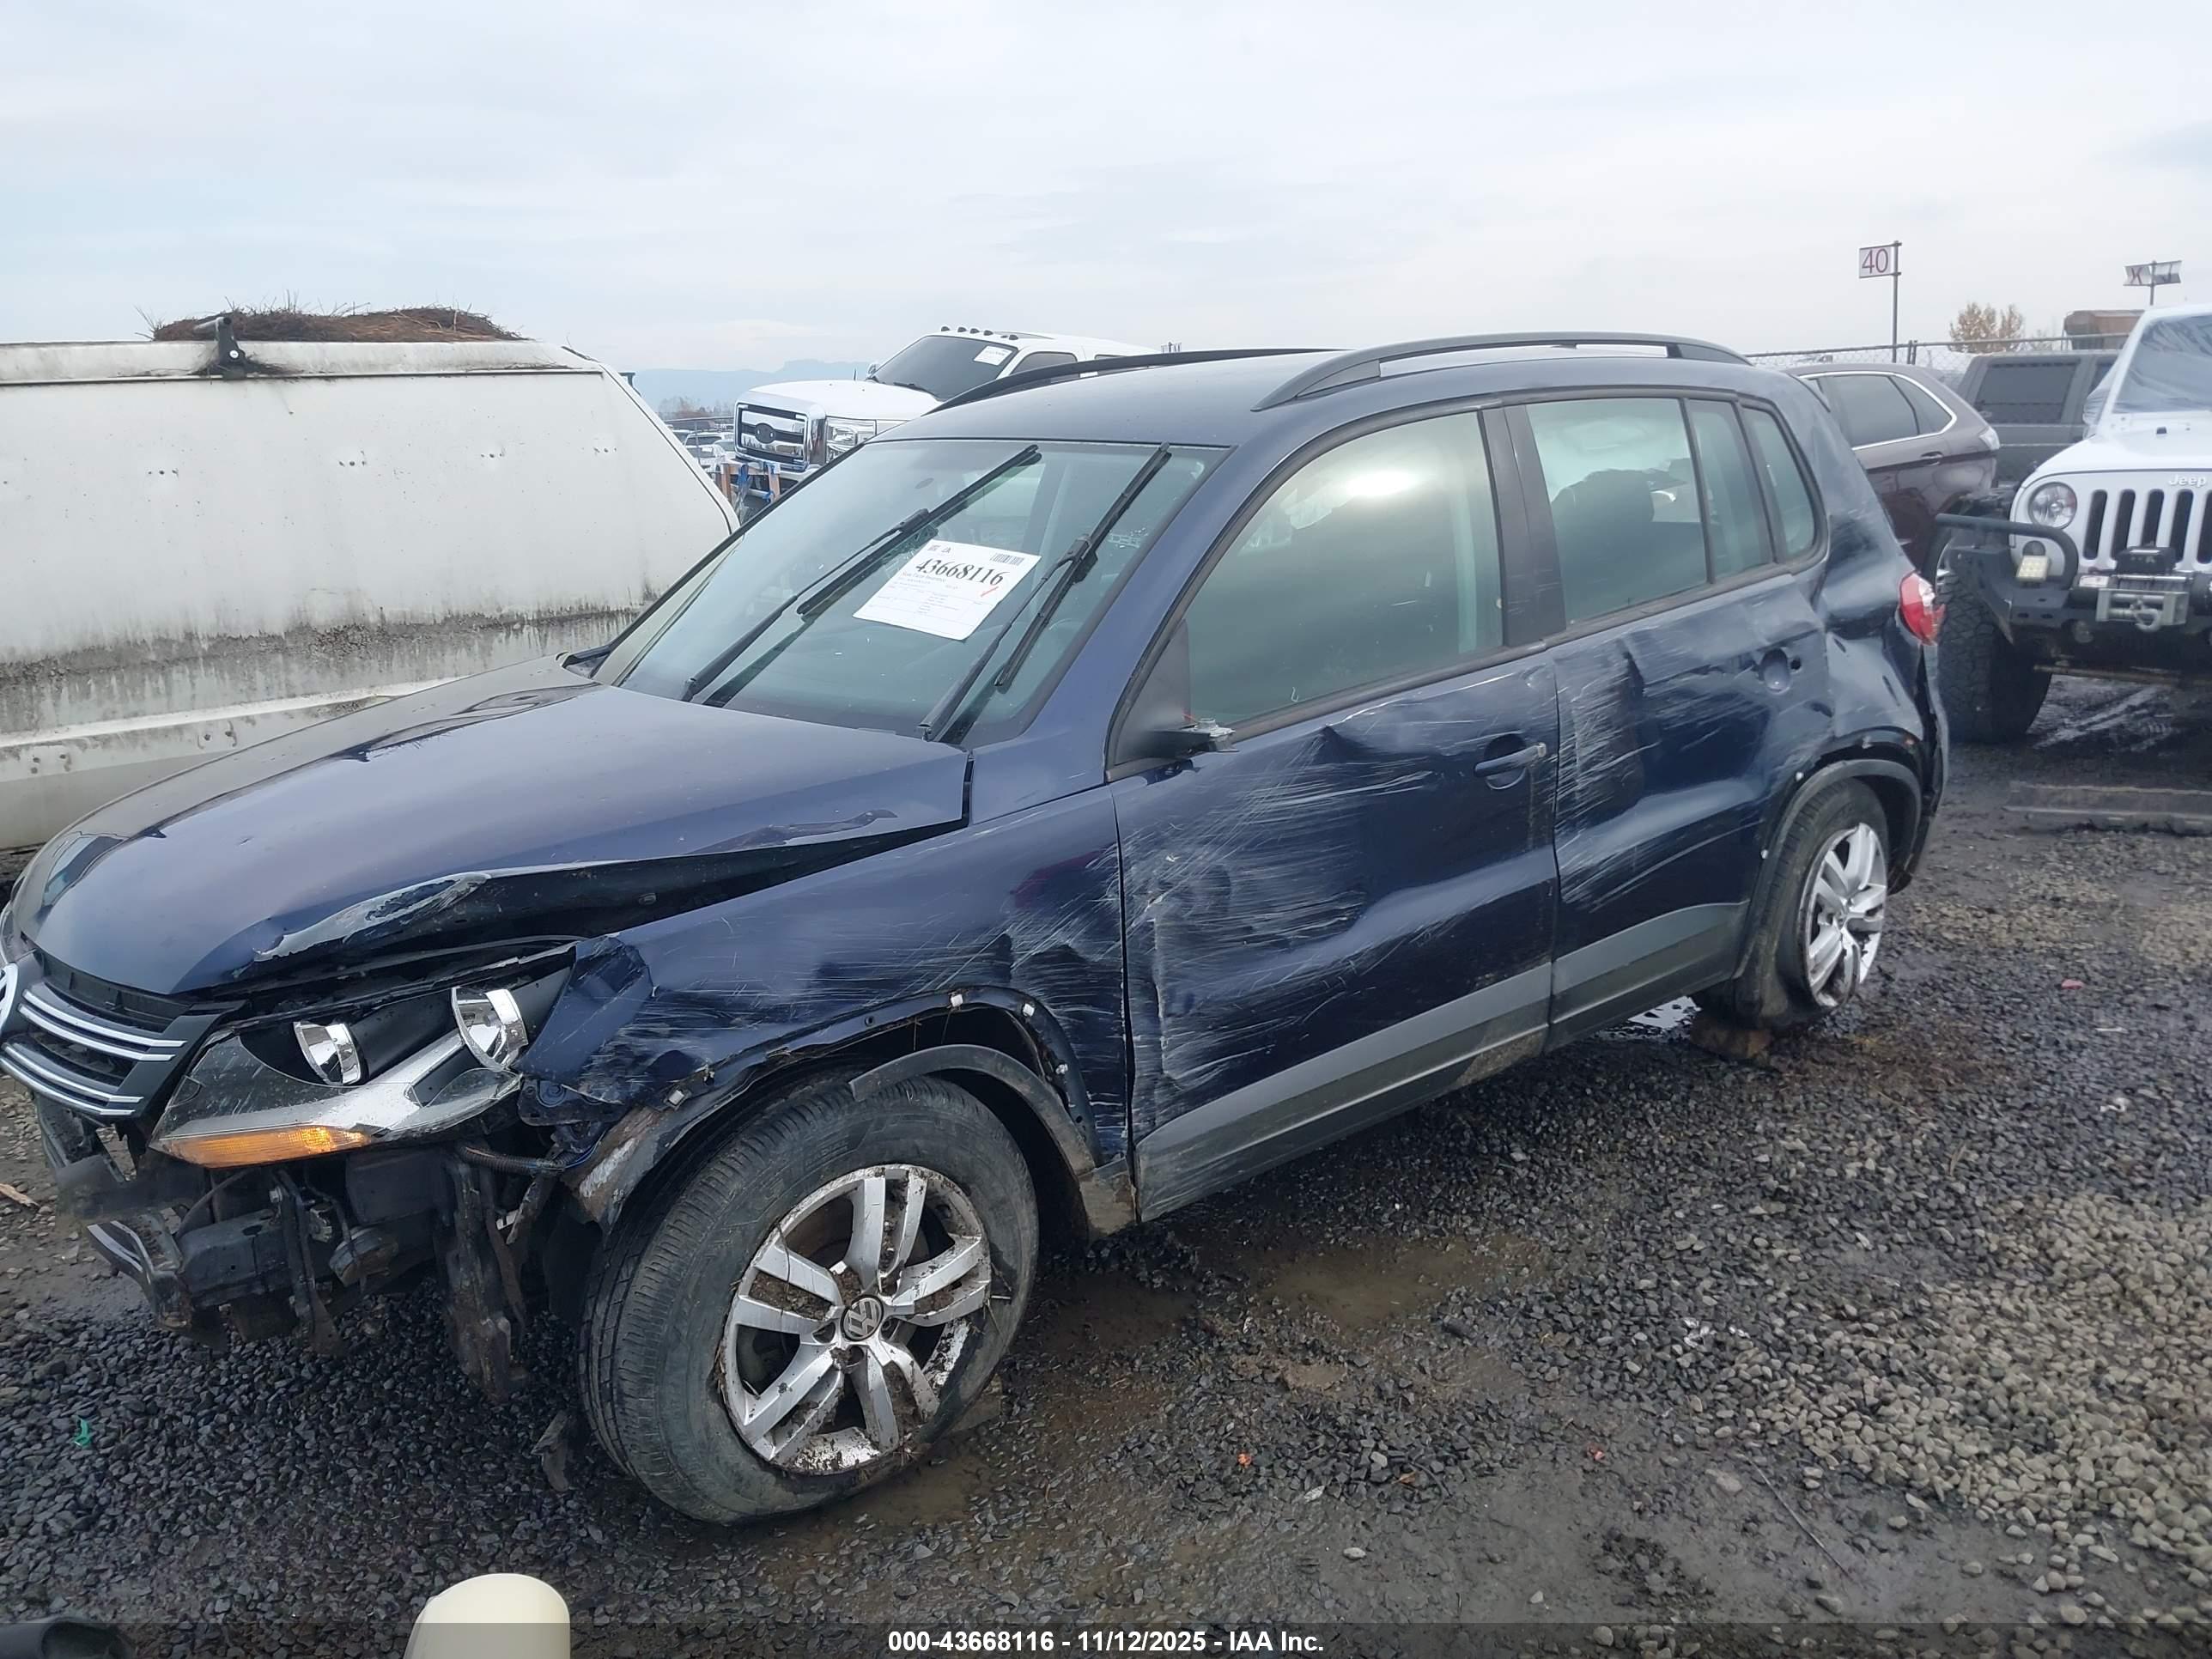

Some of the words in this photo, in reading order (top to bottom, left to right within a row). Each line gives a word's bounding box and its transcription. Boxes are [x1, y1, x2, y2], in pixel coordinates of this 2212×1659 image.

[1862, 249, 1888, 274] 40
[2168, 473, 2207, 488] Jeep
[915, 558, 1010, 586] 43668116
